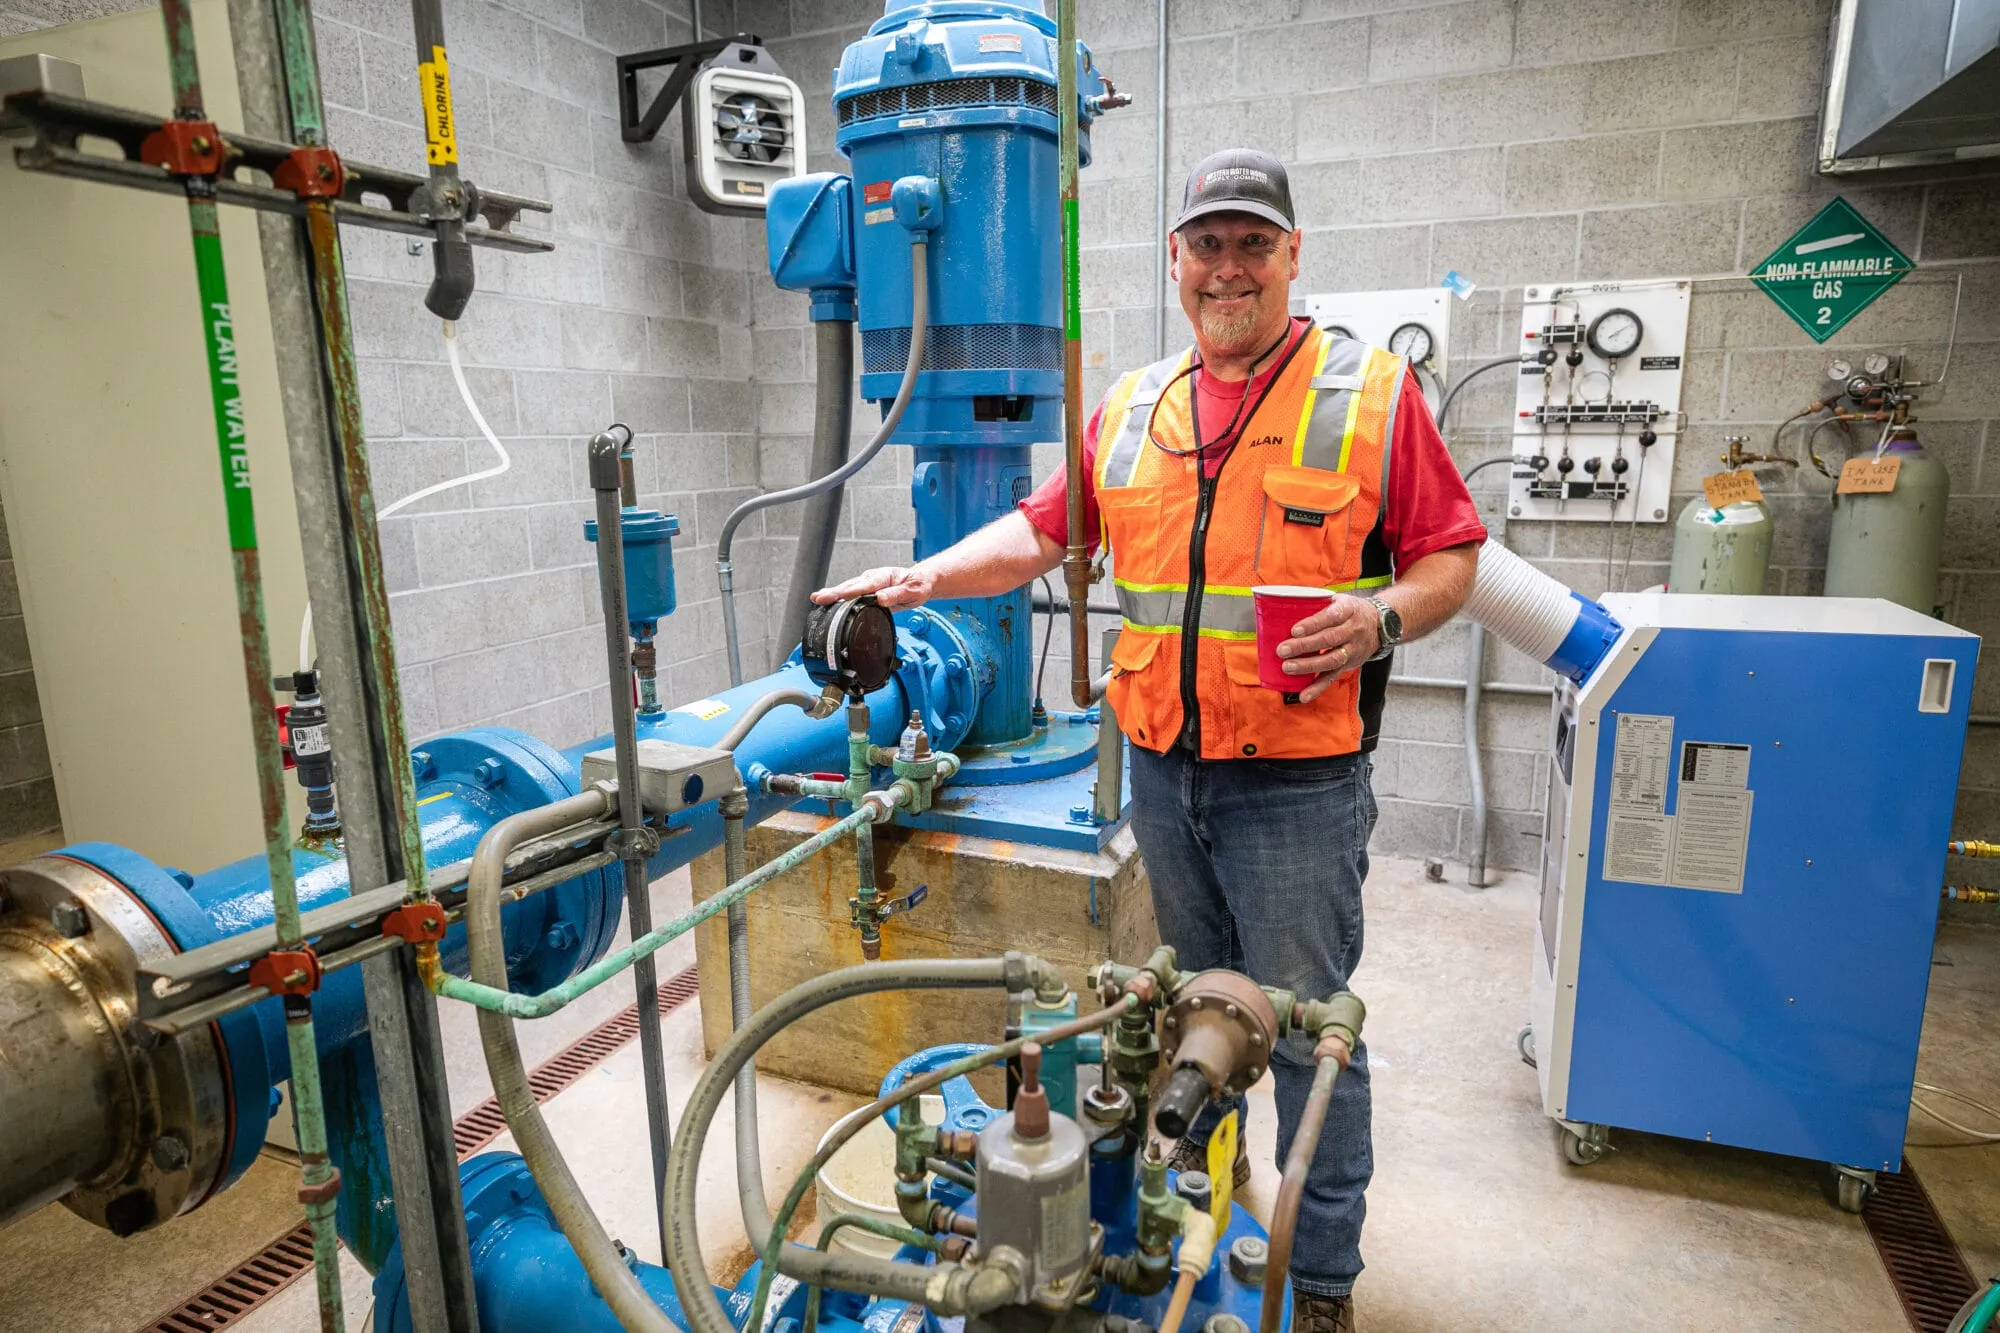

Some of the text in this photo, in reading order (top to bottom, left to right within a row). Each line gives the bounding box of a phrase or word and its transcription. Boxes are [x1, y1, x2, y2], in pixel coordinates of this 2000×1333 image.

[434, 72, 450, 138] CHLORINE
[1812, 280, 1843, 299] GAS
[1816, 306, 1832, 325] 2
[211, 302, 251, 489] PLANT WATER
[1248, 436, 1283, 449] ALAN
[1846, 464, 1896, 477] IN USE
[1853, 478, 1884, 487] TANK
[1719, 490, 1747, 500] TANK
